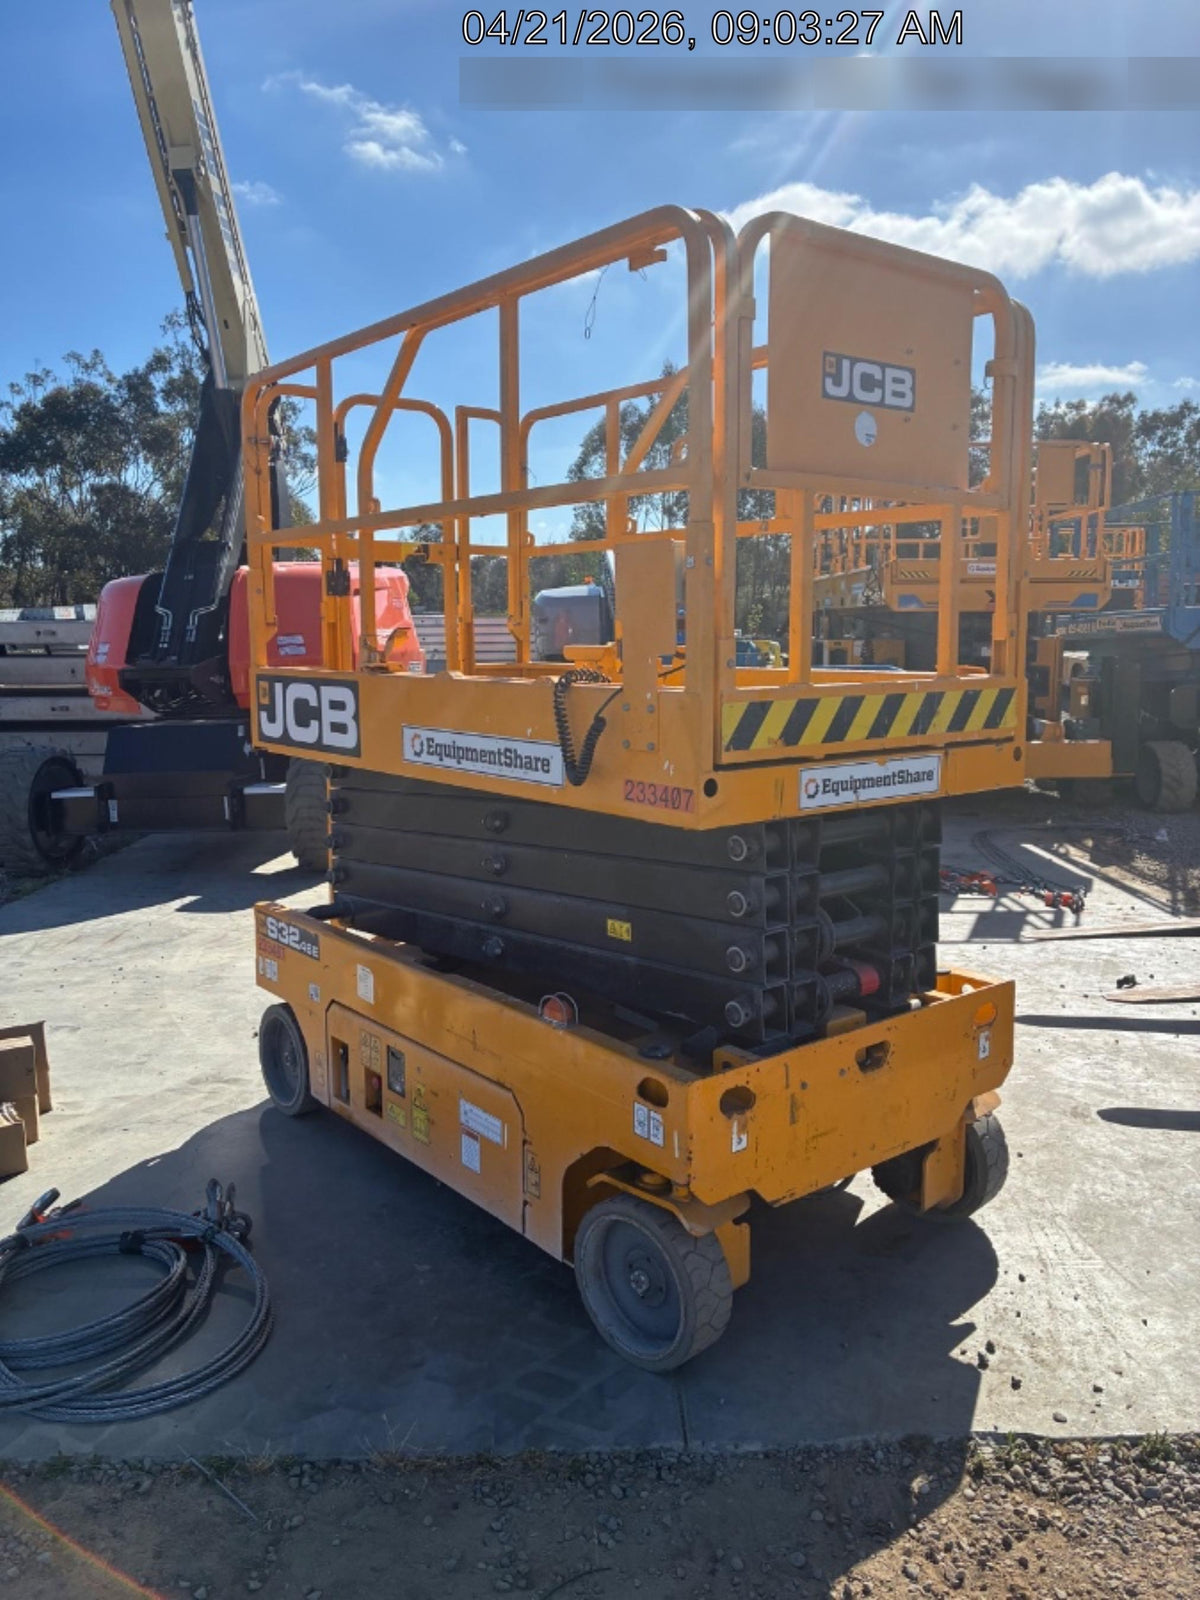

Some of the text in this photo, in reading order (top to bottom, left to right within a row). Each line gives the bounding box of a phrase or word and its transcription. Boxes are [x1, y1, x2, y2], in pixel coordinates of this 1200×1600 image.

[824, 358, 914, 408] JCB
[259, 681, 358, 749] JCB
[426, 736, 551, 774] EquipmentShare
[624, 780, 694, 810] 233407
[821, 769, 935, 798] EquipmentShare
